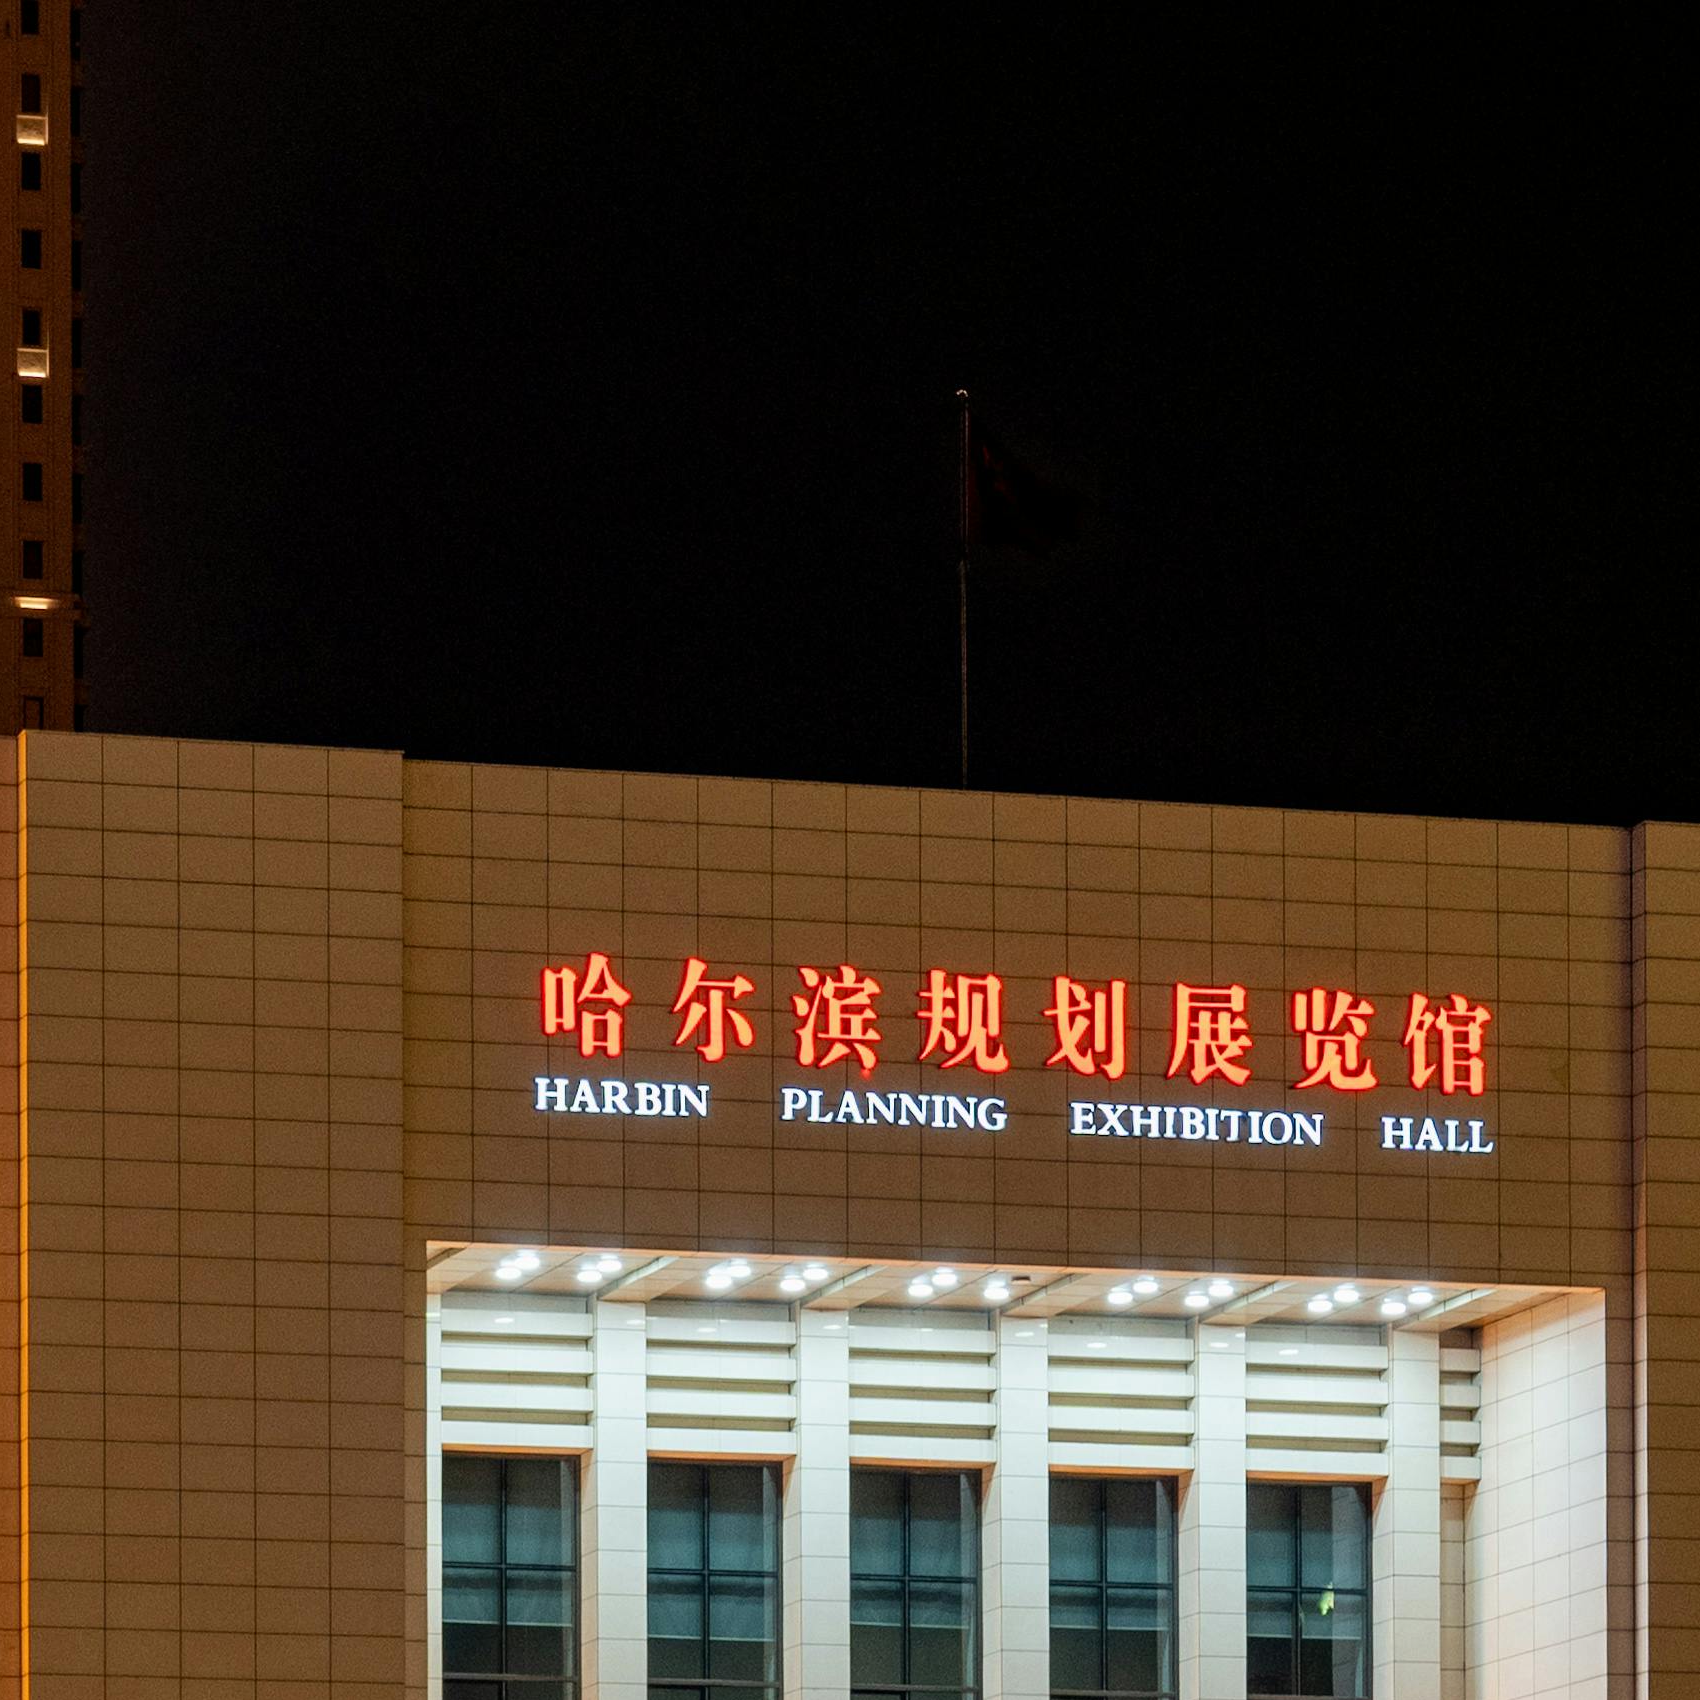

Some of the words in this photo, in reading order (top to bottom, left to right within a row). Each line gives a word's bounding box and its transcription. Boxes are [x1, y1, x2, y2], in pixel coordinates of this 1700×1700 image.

[541, 951, 1493, 1097] 哈尔滨规划展览馆
[534, 1076, 710, 1118] HARBIN
[781, 1087, 1008, 1132] PLANNING
[1070, 1102, 1324, 1147] EXHIBITION
[1381, 1116, 1494, 1154] HALL
